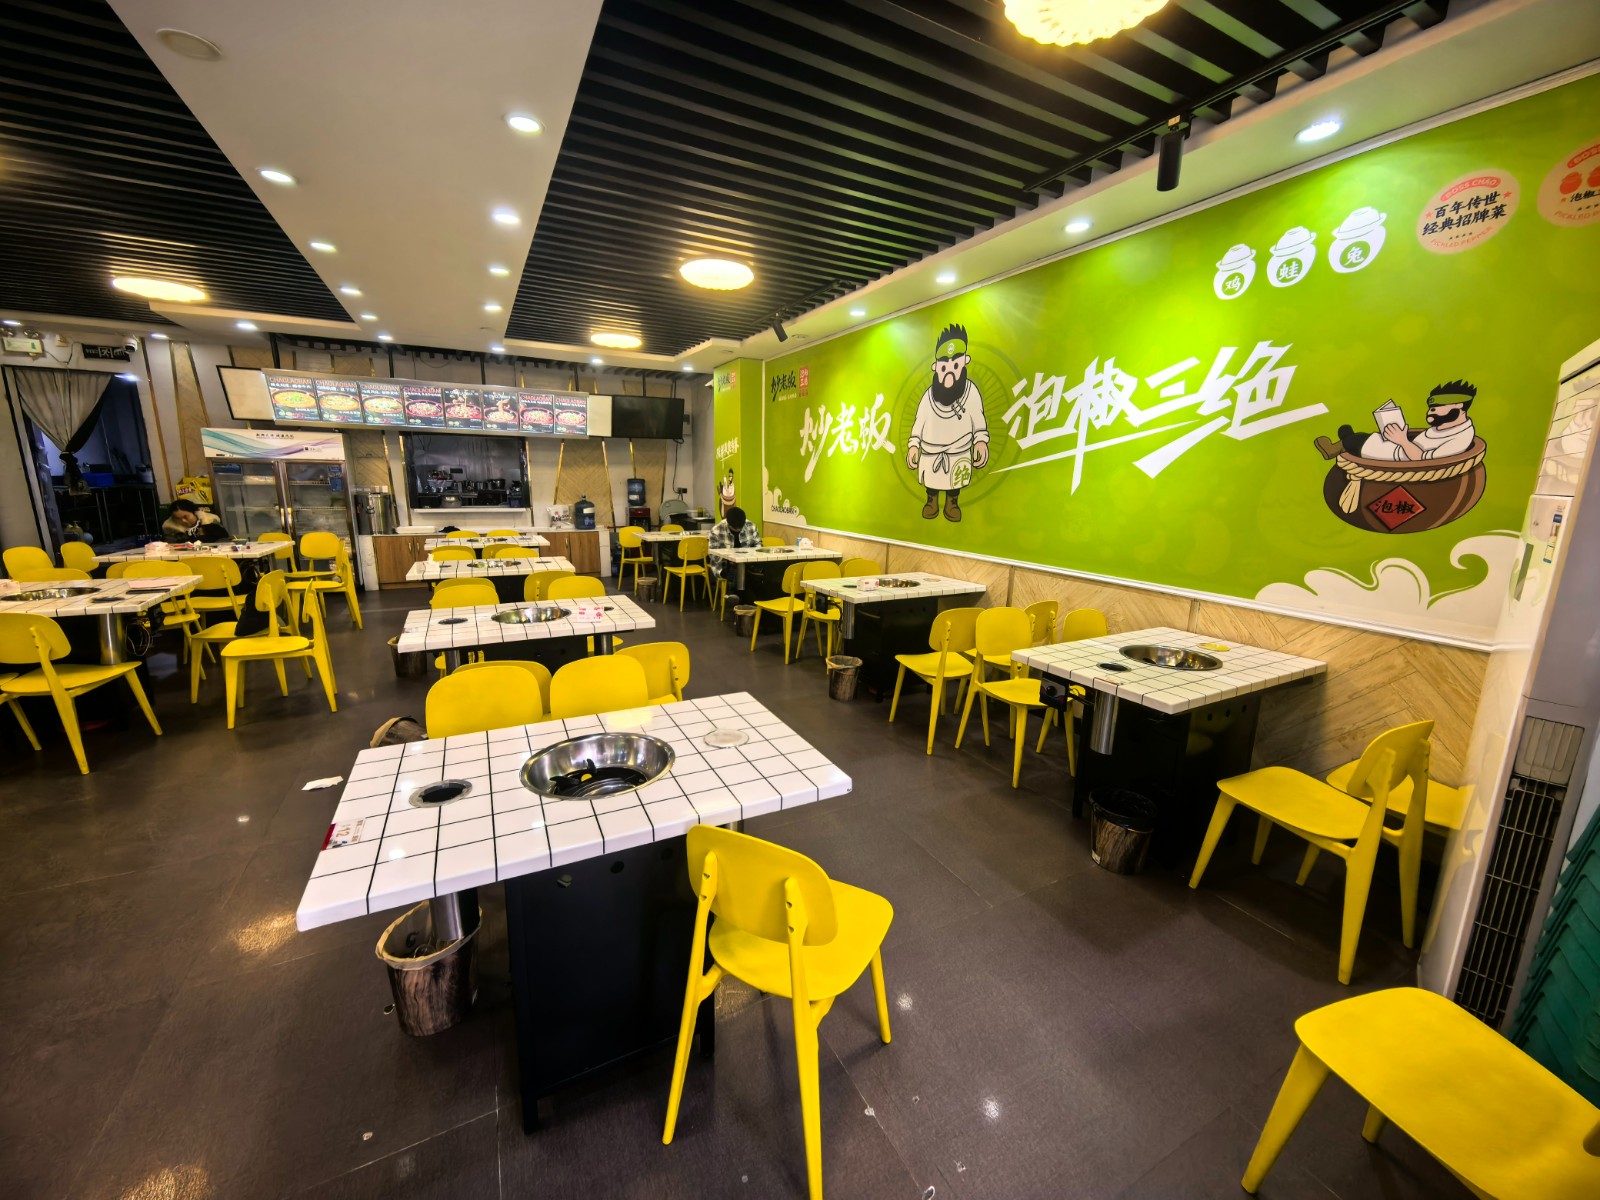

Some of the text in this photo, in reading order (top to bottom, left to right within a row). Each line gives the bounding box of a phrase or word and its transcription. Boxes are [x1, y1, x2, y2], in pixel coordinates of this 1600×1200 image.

[1472, 178, 1497, 186] CHAO
[1434, 191, 1501, 218] 百年传世
[1422, 204, 1508, 236] 经典招牌菜
[1344, 246, 1364, 266] 兔
[1279, 261, 1300, 280] 蛙
[1225, 275, 1242, 291] 鸡
[1000, 340, 1330, 496] 泡椒三绝
[954, 465, 971, 487] 绝
[1374, 500, 1416, 515] 泡椒
